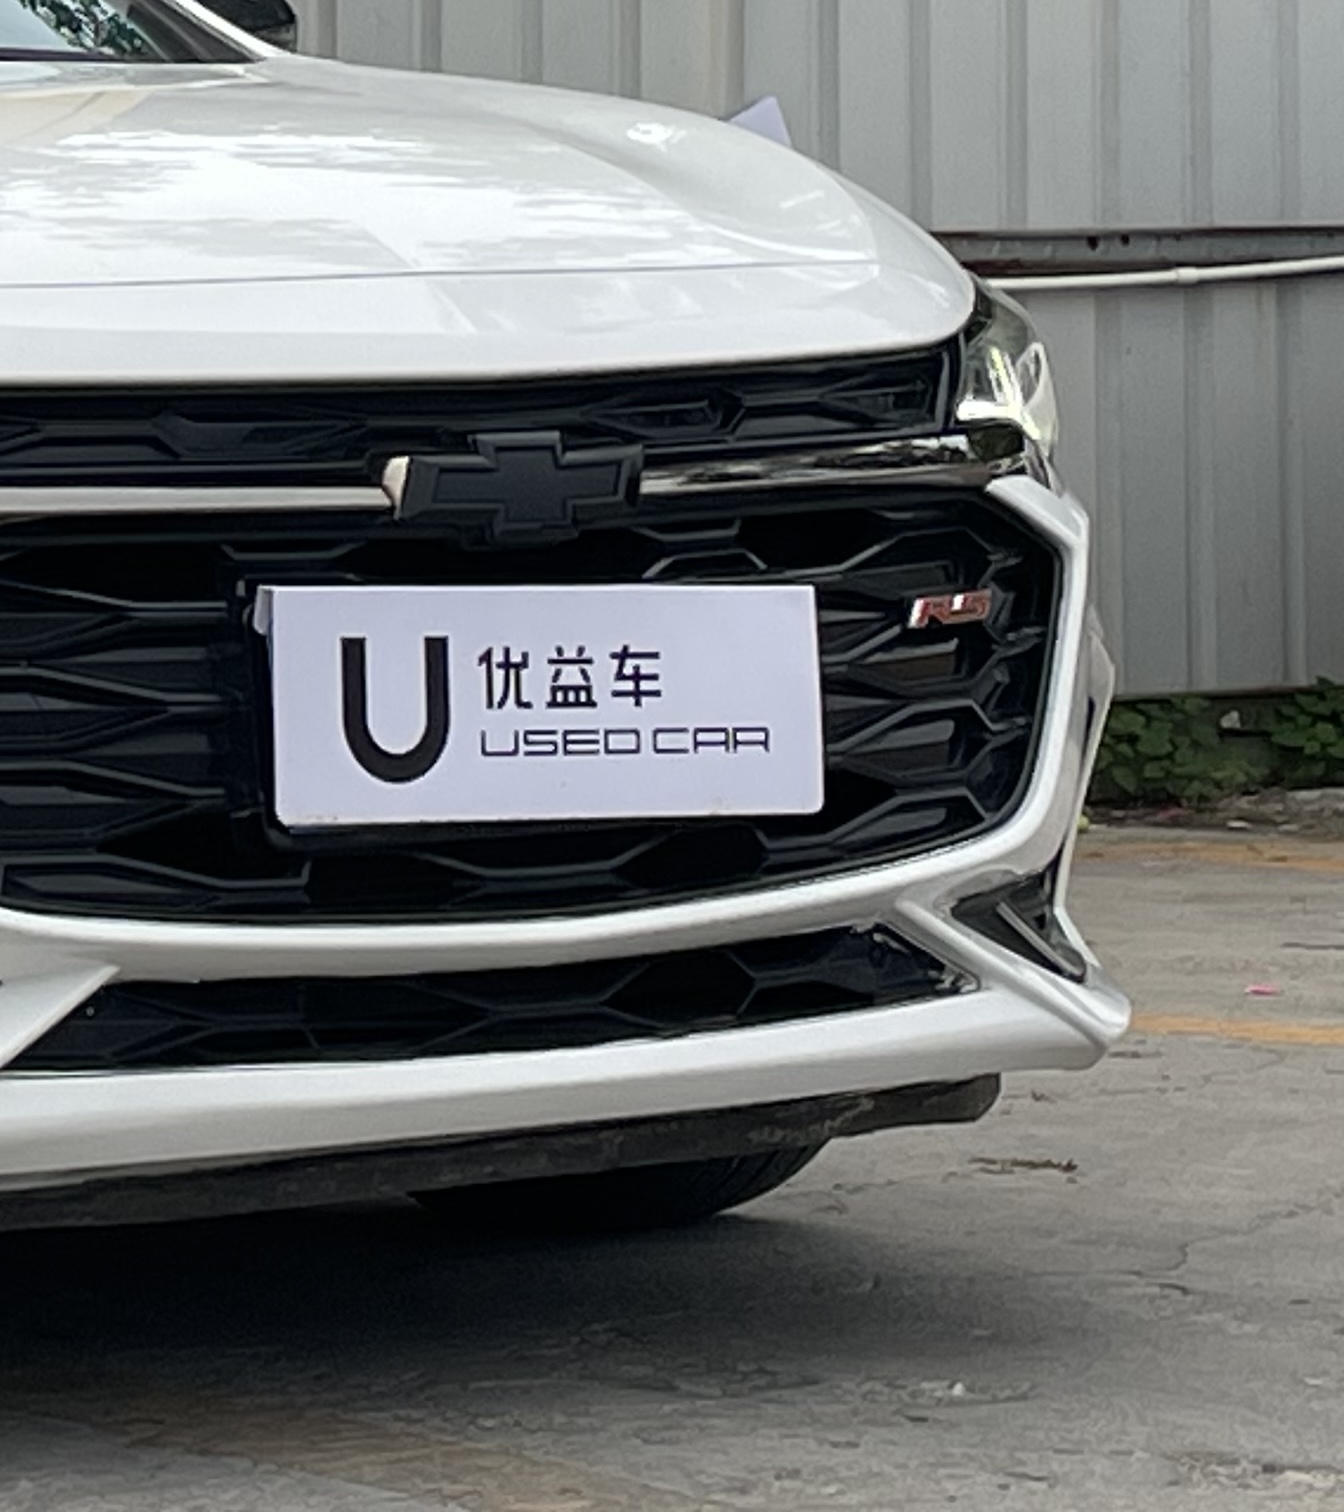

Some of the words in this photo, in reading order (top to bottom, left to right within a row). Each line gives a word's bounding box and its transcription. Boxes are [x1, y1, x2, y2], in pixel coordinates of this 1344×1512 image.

[340, 636, 450, 783] U
[478, 645, 662, 710] 优益车
[480, 728, 641, 757] USED
[652, 726, 771, 755] CAR
